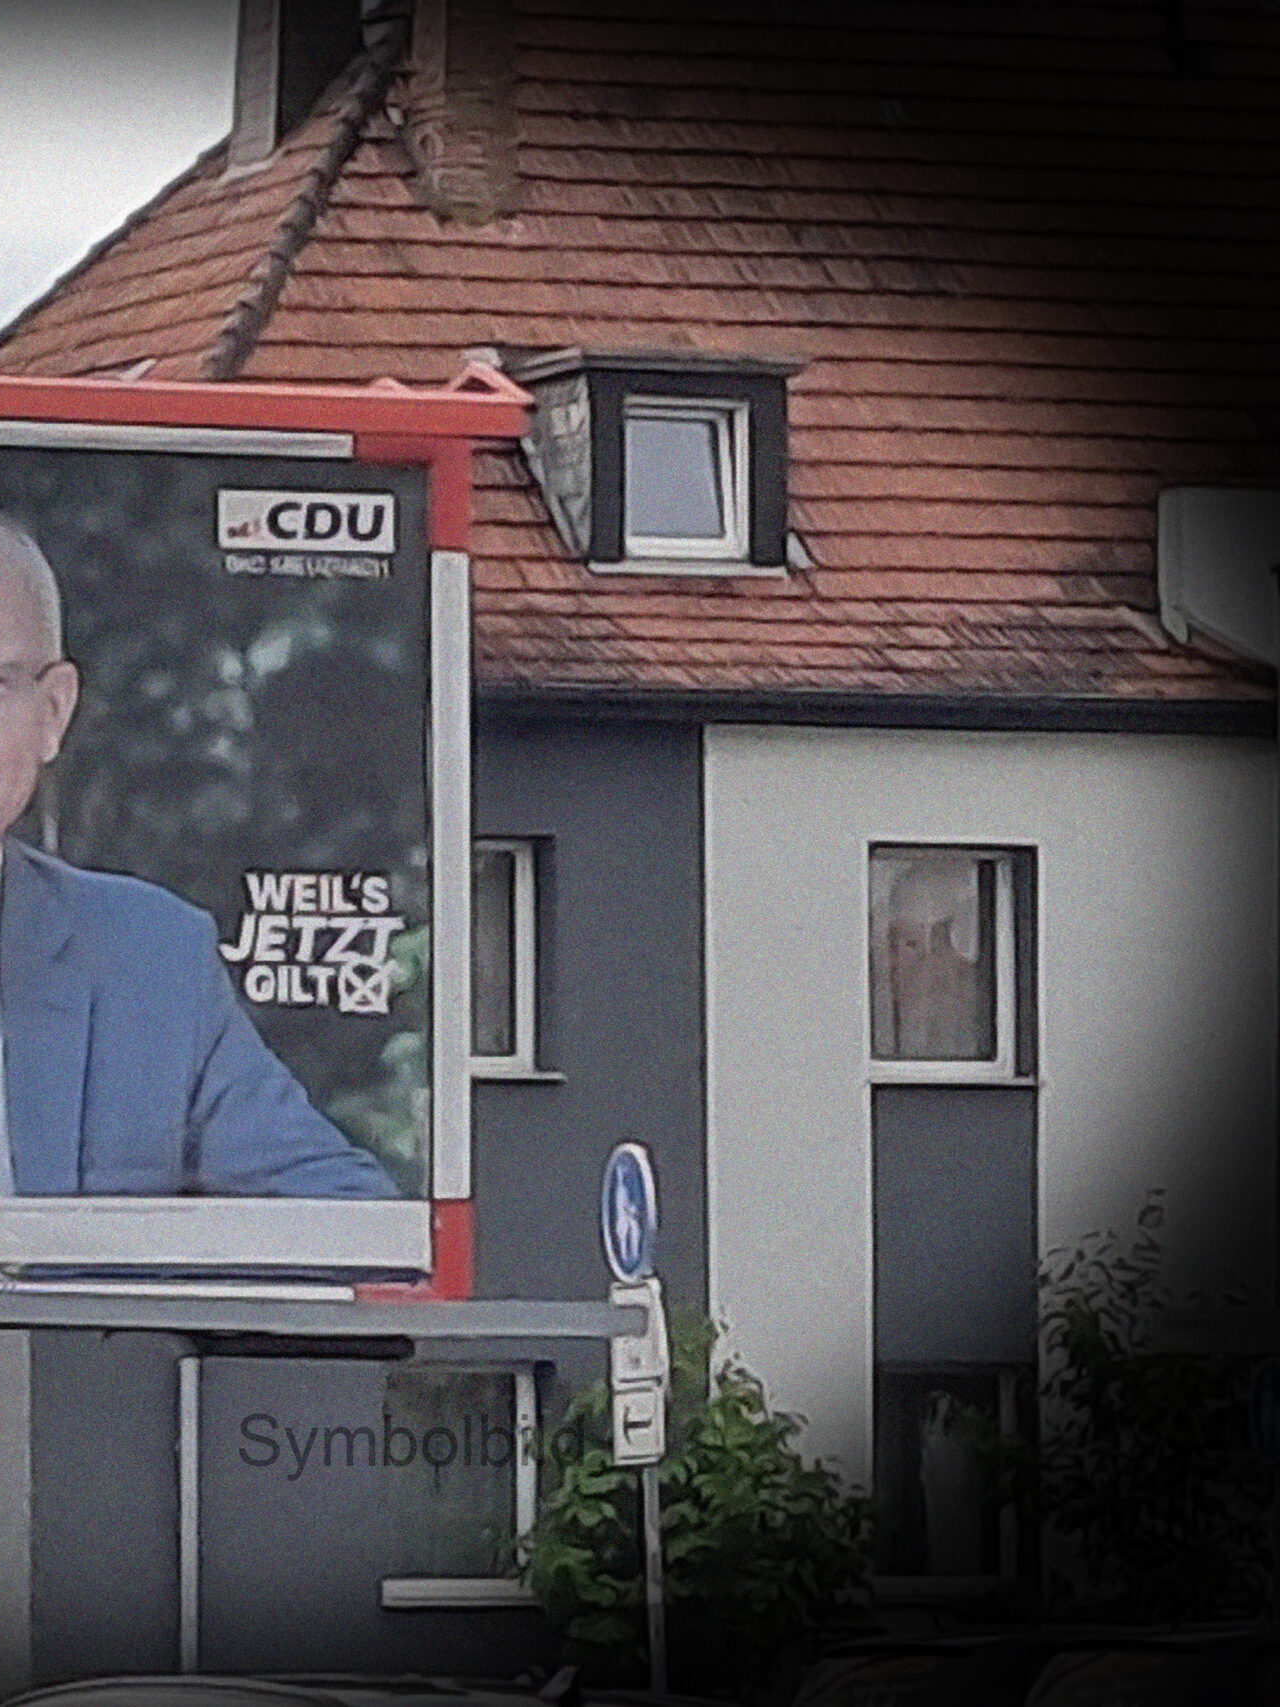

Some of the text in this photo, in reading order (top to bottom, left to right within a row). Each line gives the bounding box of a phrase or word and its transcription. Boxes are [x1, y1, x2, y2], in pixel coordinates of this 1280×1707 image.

[266, 501, 384, 541] CDU
[220, 912, 405, 963] JETZT
[245, 964, 336, 1004] GILT
